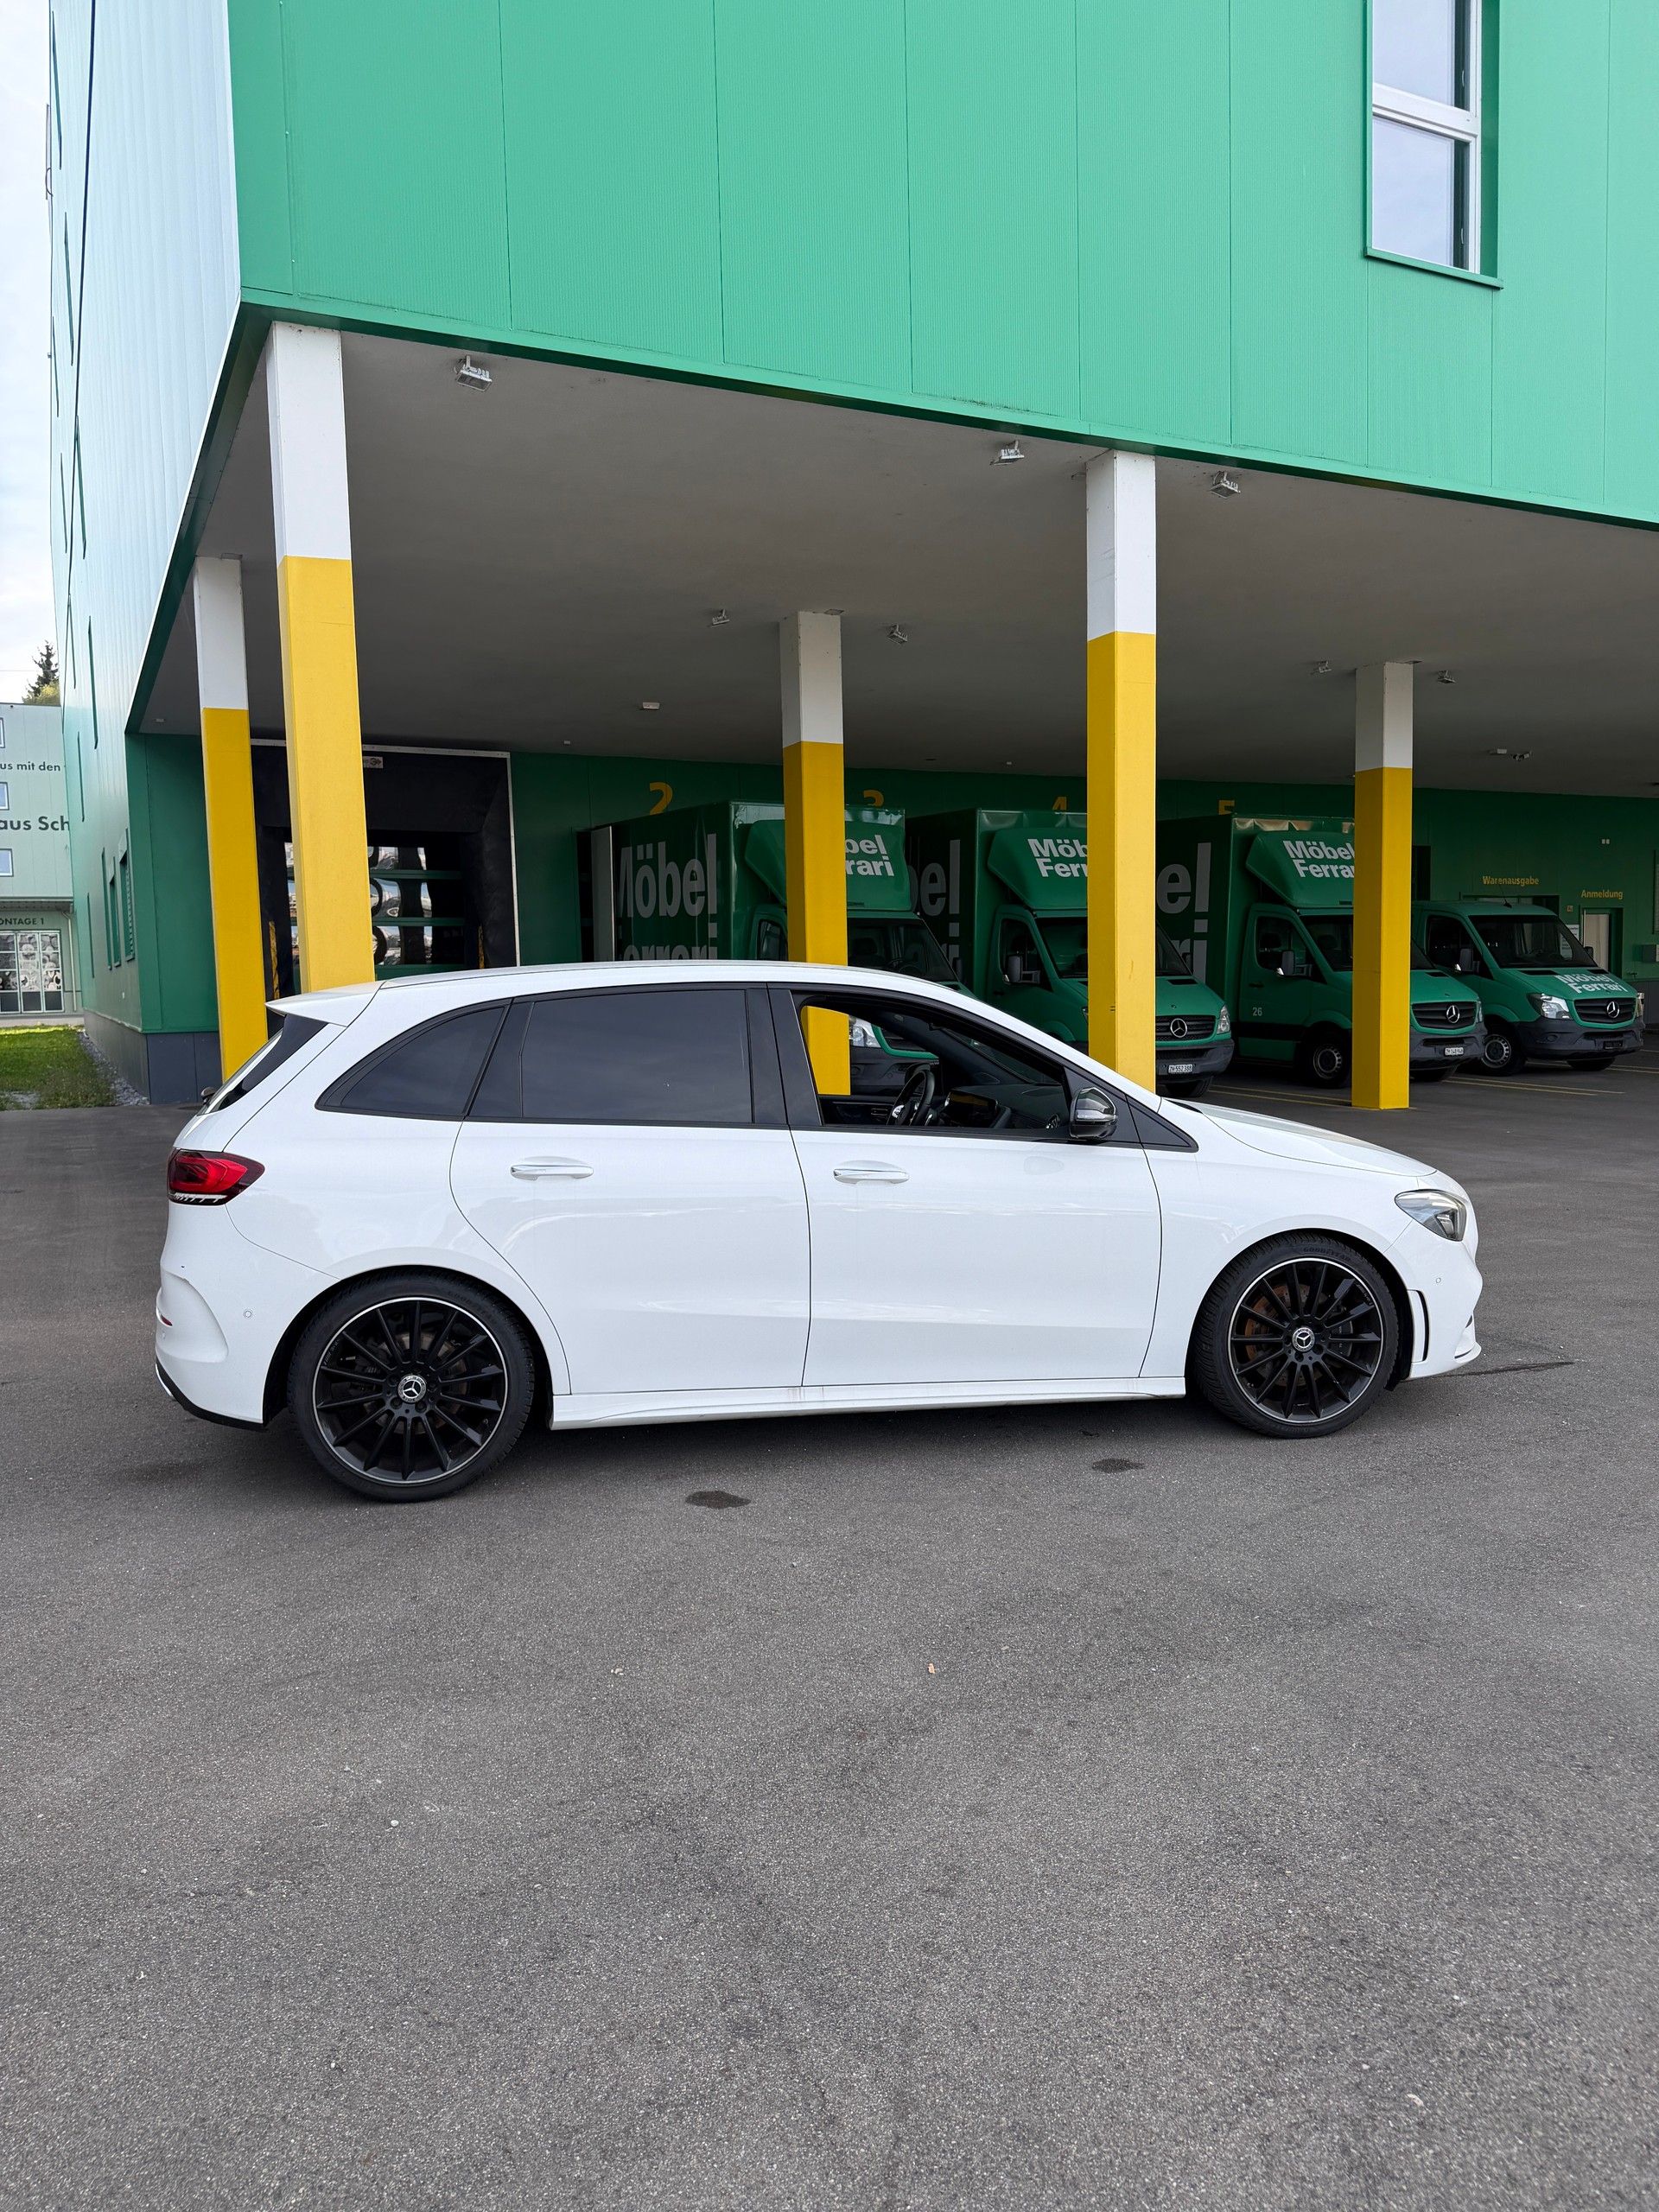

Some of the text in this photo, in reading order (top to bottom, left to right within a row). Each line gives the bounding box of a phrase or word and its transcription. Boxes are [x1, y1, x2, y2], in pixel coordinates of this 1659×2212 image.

[17, 761, 35, 771] mit
[39, 761, 60, 771] den
[1482, 875, 1539, 887] Warenausgabe
[1580, 889, 1624, 899] Anmeldung
[1252, 1007, 1262, 1017] 26
